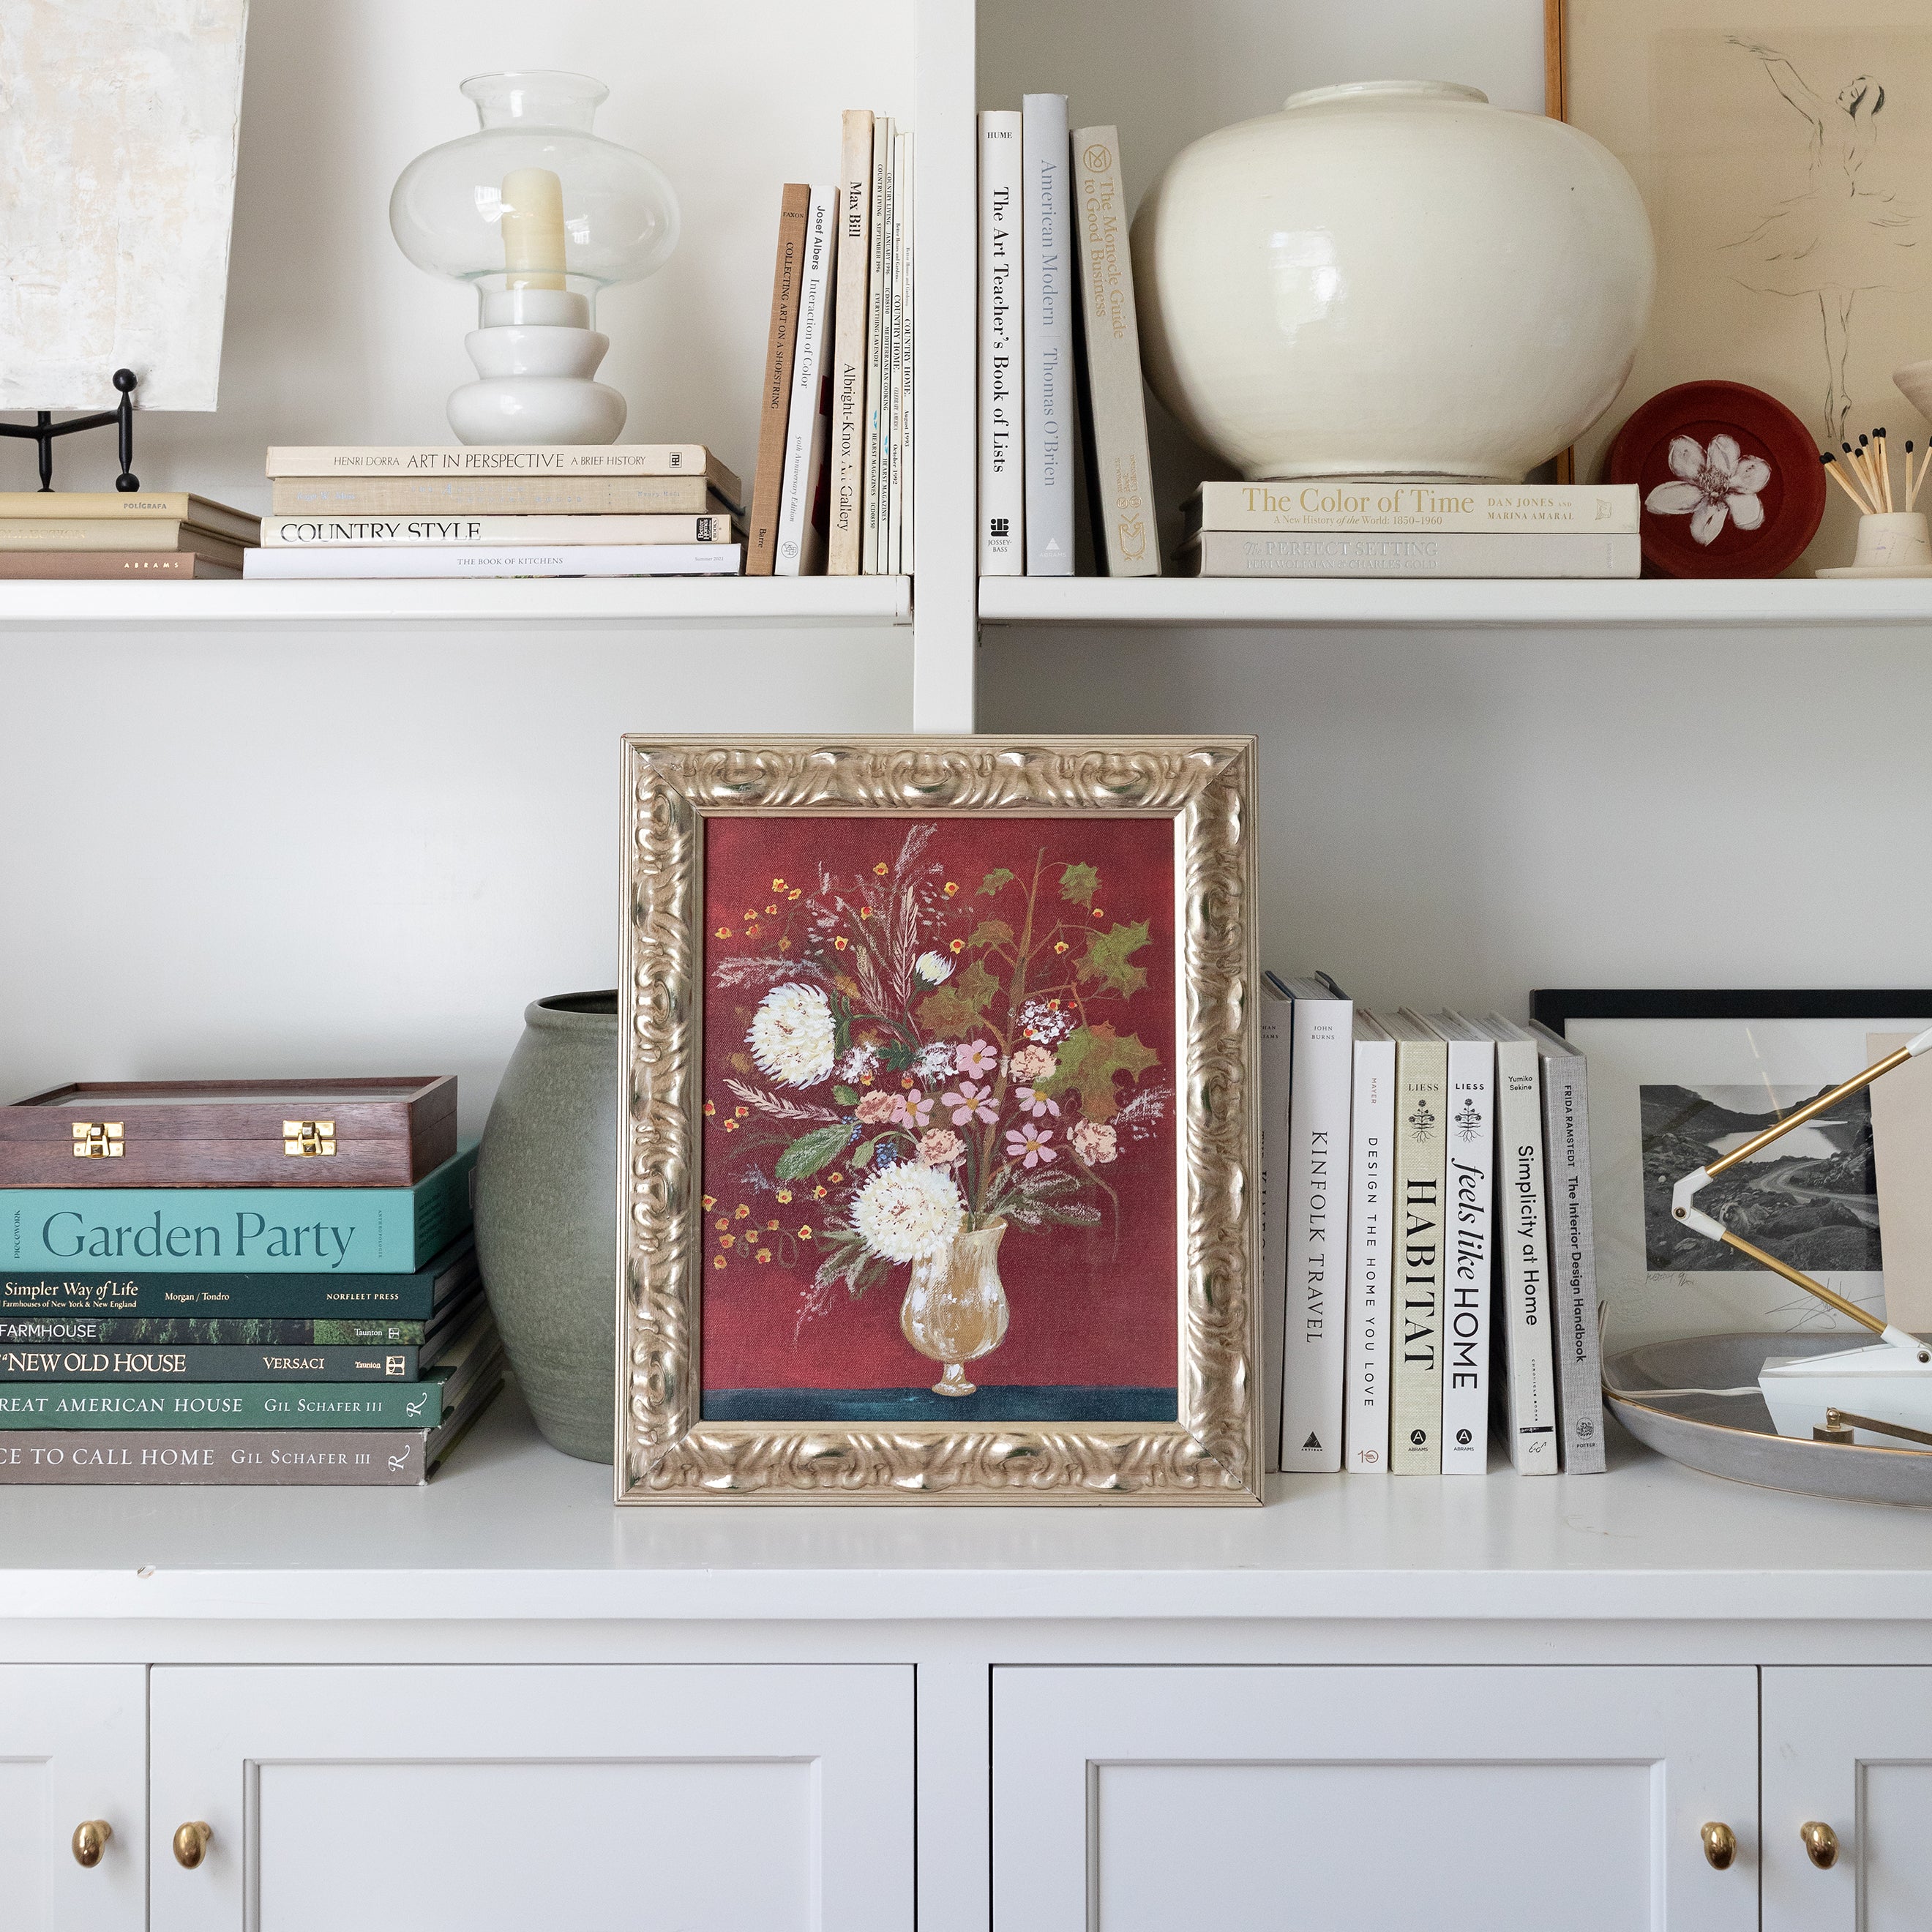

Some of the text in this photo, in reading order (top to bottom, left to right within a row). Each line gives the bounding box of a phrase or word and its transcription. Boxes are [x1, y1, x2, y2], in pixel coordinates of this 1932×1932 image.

[849, 181, 862, 237] Max Bill
[812, 206, 825, 270] Josef Albers
[1041, 160, 1058, 326] American Modern
[1085, 179, 1106, 318] to Good Business
[1100, 177, 1127, 339] The Monocle Guide
[780, 242, 793, 301] COLLECTING
[779, 303, 788, 323] ART
[778, 325, 786, 340] ON
[801, 279, 820, 389] Interaction of Color
[993, 187, 1009, 472] The Art Teacher's Book of Lists
[771, 351, 784, 409] SHOESTRING
[840, 363, 855, 457] Albright-Knox
[1043, 348, 1059, 487] Thomas O'Brien
[334, 456, 400, 466] HENRI DORRA
[407, 453, 564, 468] ART IN PERSPECTIVE
[571, 456, 646, 465] A BRIEF HISTORY
[790, 453, 802, 522] Anniversary Edition
[837, 485, 853, 531] Gallery
[1242, 487, 1475, 513] The Color of Time
[1488, 498, 1513, 506] DAN
[1516, 498, 1554, 507] JONES
[1273, 515, 1390, 527] A New History of the World:
[1487, 512, 1574, 520] MARINA AMARAL
[280, 523, 482, 542] COUNTRY STYLE
[757, 528, 766, 548] Barre
[1266, 542, 1438, 557] PERFECT SETTING
[1247, 559, 1402, 569] PERI CHARLES
[1564, 1085, 1575, 1167] FRIDA RAMSTEDT
[42, 1210, 221, 1257] Garden
[236, 1212, 356, 1269] Party
[1306, 1131, 1328, 1343] KINFOLK TRAVEL
[1515, 1146, 1540, 1325] Simplicity at Home
[1364, 1137, 1378, 1406] DESIGN THE HOME YOU LOVE
[1404, 1178, 1437, 1371] HABITAT
[1451, 1158, 1485, 1389] feels like HOME
[1568, 1176, 1587, 1363] The Interior Design Handbook
[4, 1281, 138, 1300] Simpler Way of Life
[165, 1292, 230, 1302] Morgan Tondro
[3, 1300, 41, 1308] Farmhouses
[42, 1300, 52, 1308] of
[92, 1300, 108, 1308] New
[110, 1300, 137, 1310] England
[0, 1324, 97, 1338] FARMHOUSE
[354, 1328, 383, 1336] Taunton
[8, 1352, 187, 1373] NEW OLD HOUSE
[263, 1357, 325, 1369] VERSACI
[56, 1399, 243, 1412] AMERICAN HOUSE
[297, 1399, 362, 1412] SCHAFER
[30, 1448, 214, 1465] TO CALL HOME
[271, 1449, 348, 1464] SCHAFER
